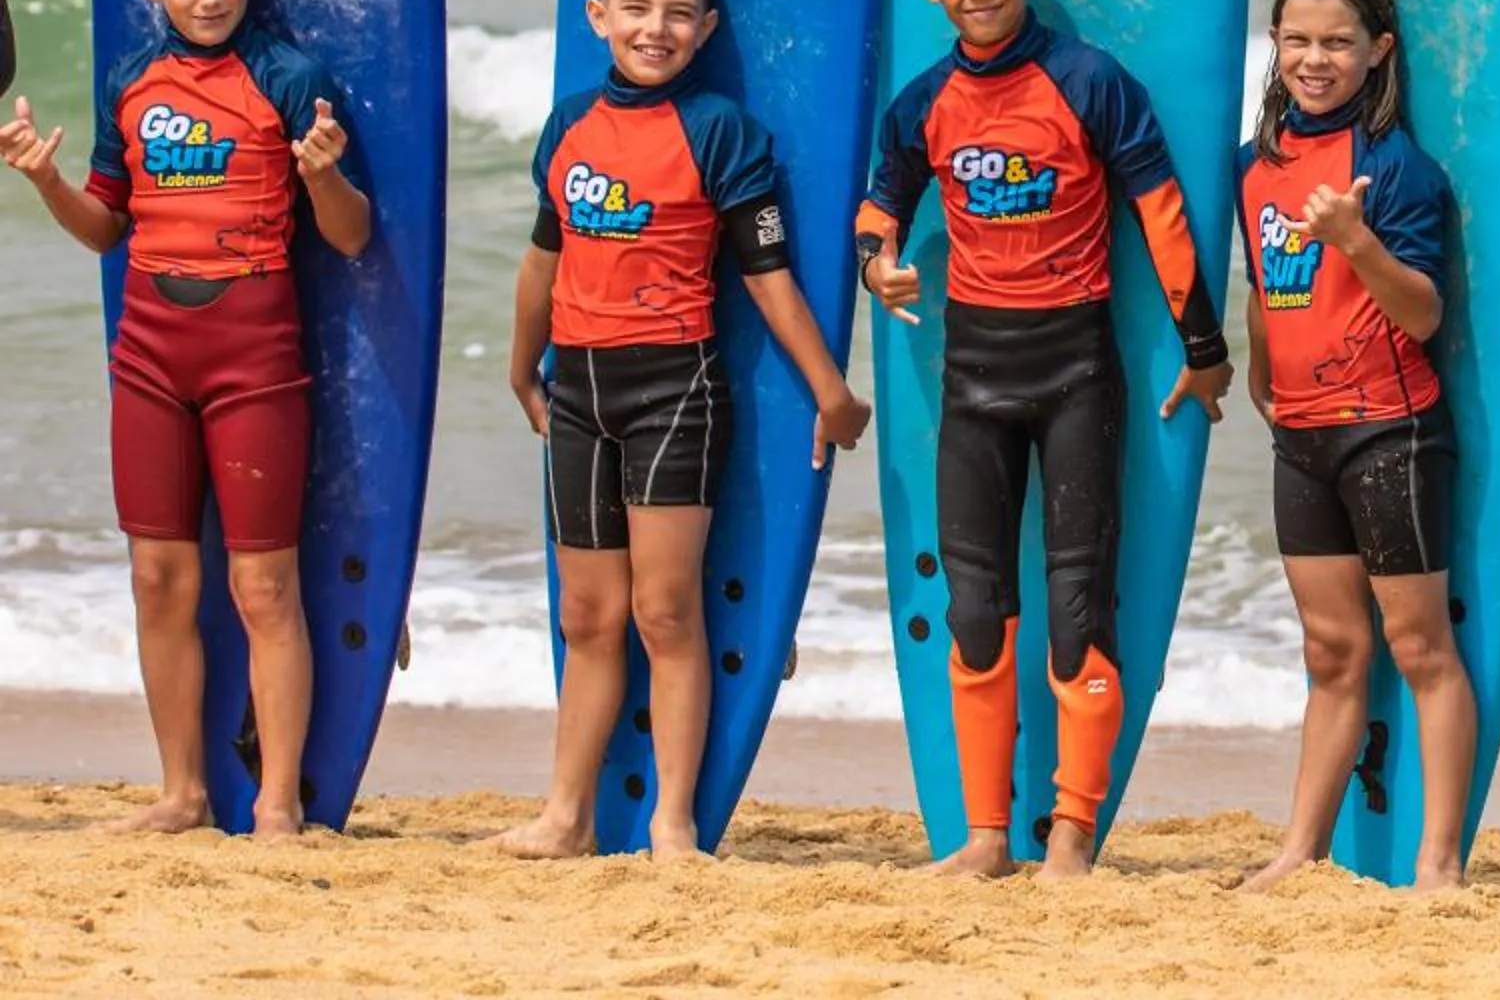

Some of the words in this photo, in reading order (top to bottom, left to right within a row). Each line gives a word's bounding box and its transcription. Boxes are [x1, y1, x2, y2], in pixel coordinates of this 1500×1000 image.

[140, 105, 209, 145] Go&
[146, 138, 234, 172] Surf
[565, 164, 626, 212] Go&
[968, 168, 1056, 213] Surf
[1263, 242, 1319, 289] Surf
